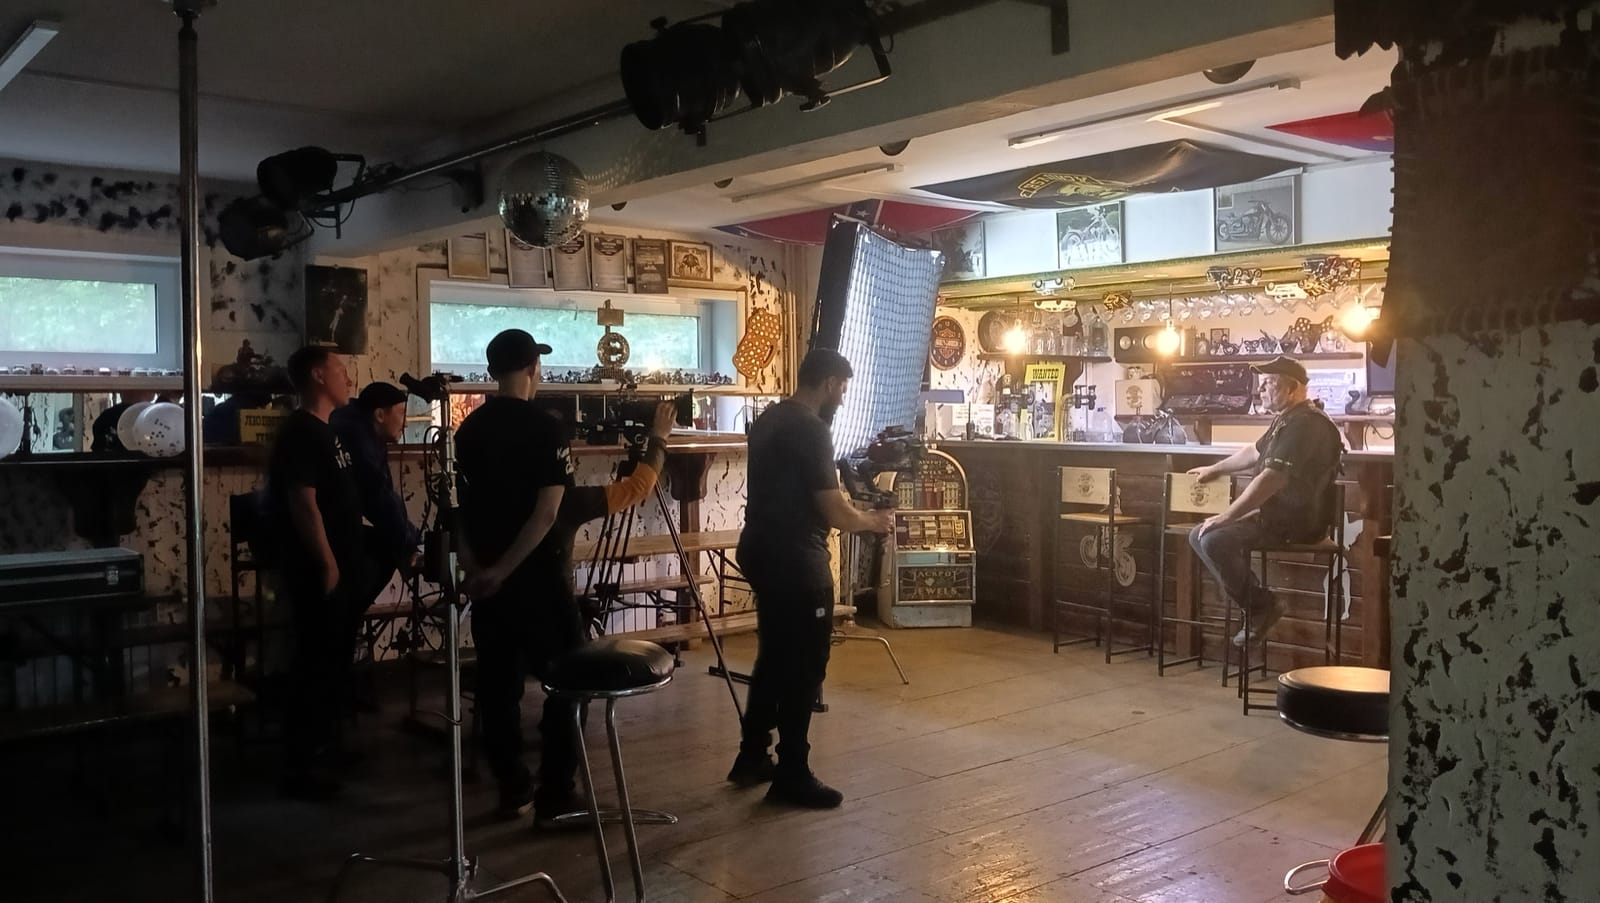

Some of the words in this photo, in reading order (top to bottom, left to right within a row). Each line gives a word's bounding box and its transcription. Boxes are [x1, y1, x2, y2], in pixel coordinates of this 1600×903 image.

[1032, 368, 1059, 380] WANTED
[913, 570, 958, 582] JACKPOT
[913, 586, 958, 598] JEWELS
